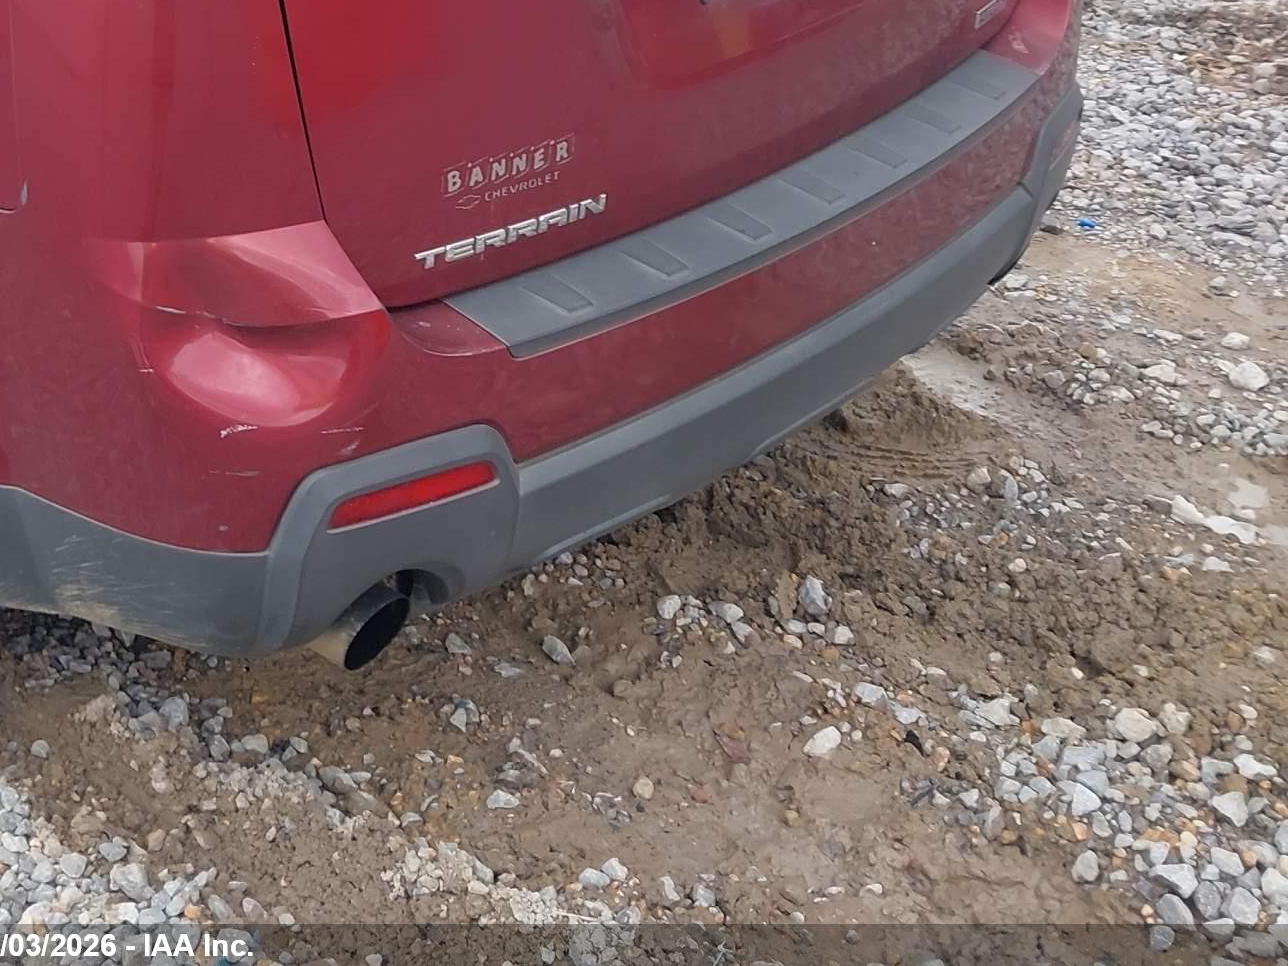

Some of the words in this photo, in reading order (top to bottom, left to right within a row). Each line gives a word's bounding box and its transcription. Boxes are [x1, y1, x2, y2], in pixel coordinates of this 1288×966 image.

[445, 140, 569, 193] BANNER
[484, 170, 561, 202] CHEVROLET
[413, 193, 607, 270] TERRAIN
